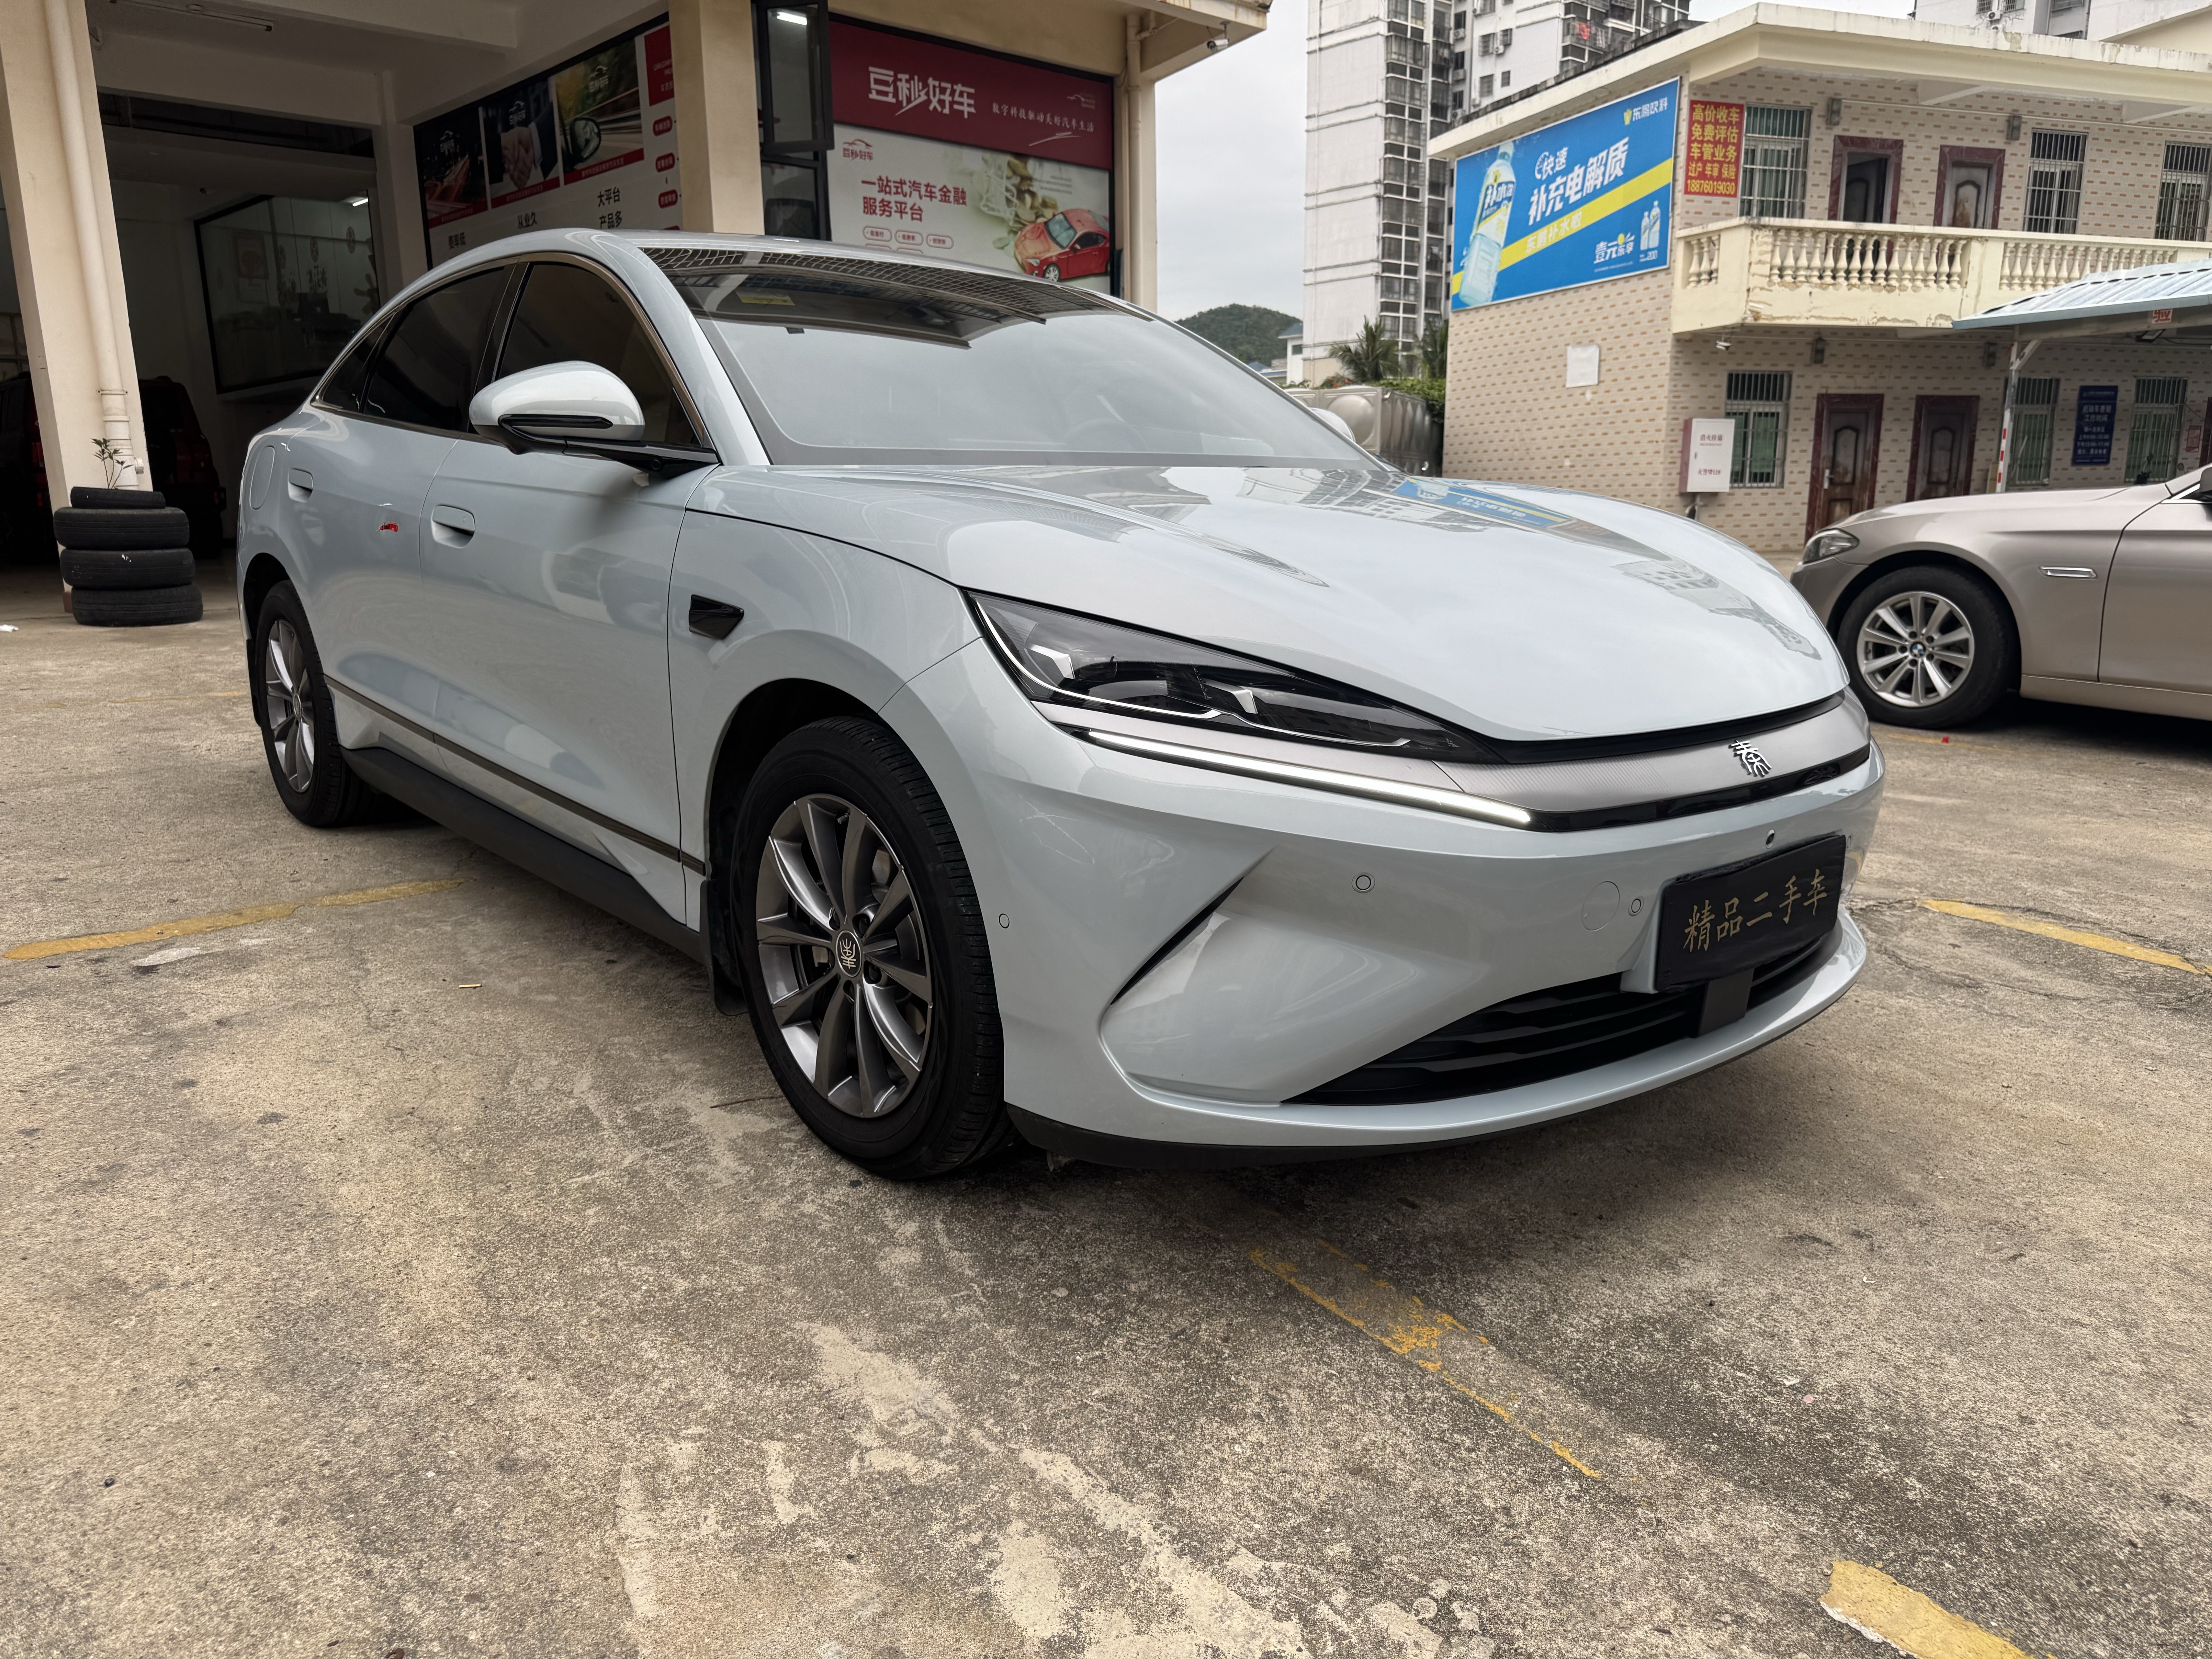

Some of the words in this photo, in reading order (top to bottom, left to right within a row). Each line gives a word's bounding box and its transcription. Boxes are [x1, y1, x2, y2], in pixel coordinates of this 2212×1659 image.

[868, 67, 976, 118] 豆秒好车
[1633, 97, 1668, 121] 东鹏饮料
[1693, 104, 1740, 124] 高价收车
[1691, 123, 1738, 143] 免费评估
[1690, 142, 1737, 162] 车管业务
[1537, 147, 1568, 180] 快速
[1688, 161, 1702, 177] 过户
[1705, 162, 1719, 178] 年审
[1722, 164, 1736, 179] 保险
[861, 175, 967, 206] 一站式汽车金融
[1528, 137, 1629, 226] 补充电解质
[1687, 180, 1735, 195] 18876019030
[597, 187, 620, 207] 大平台
[863, 196, 923, 222] 服务平台
[518, 211, 538, 229] 从业久
[599, 211, 622, 228] 产品多
[1683, 869, 1828, 952] 精品二手车
